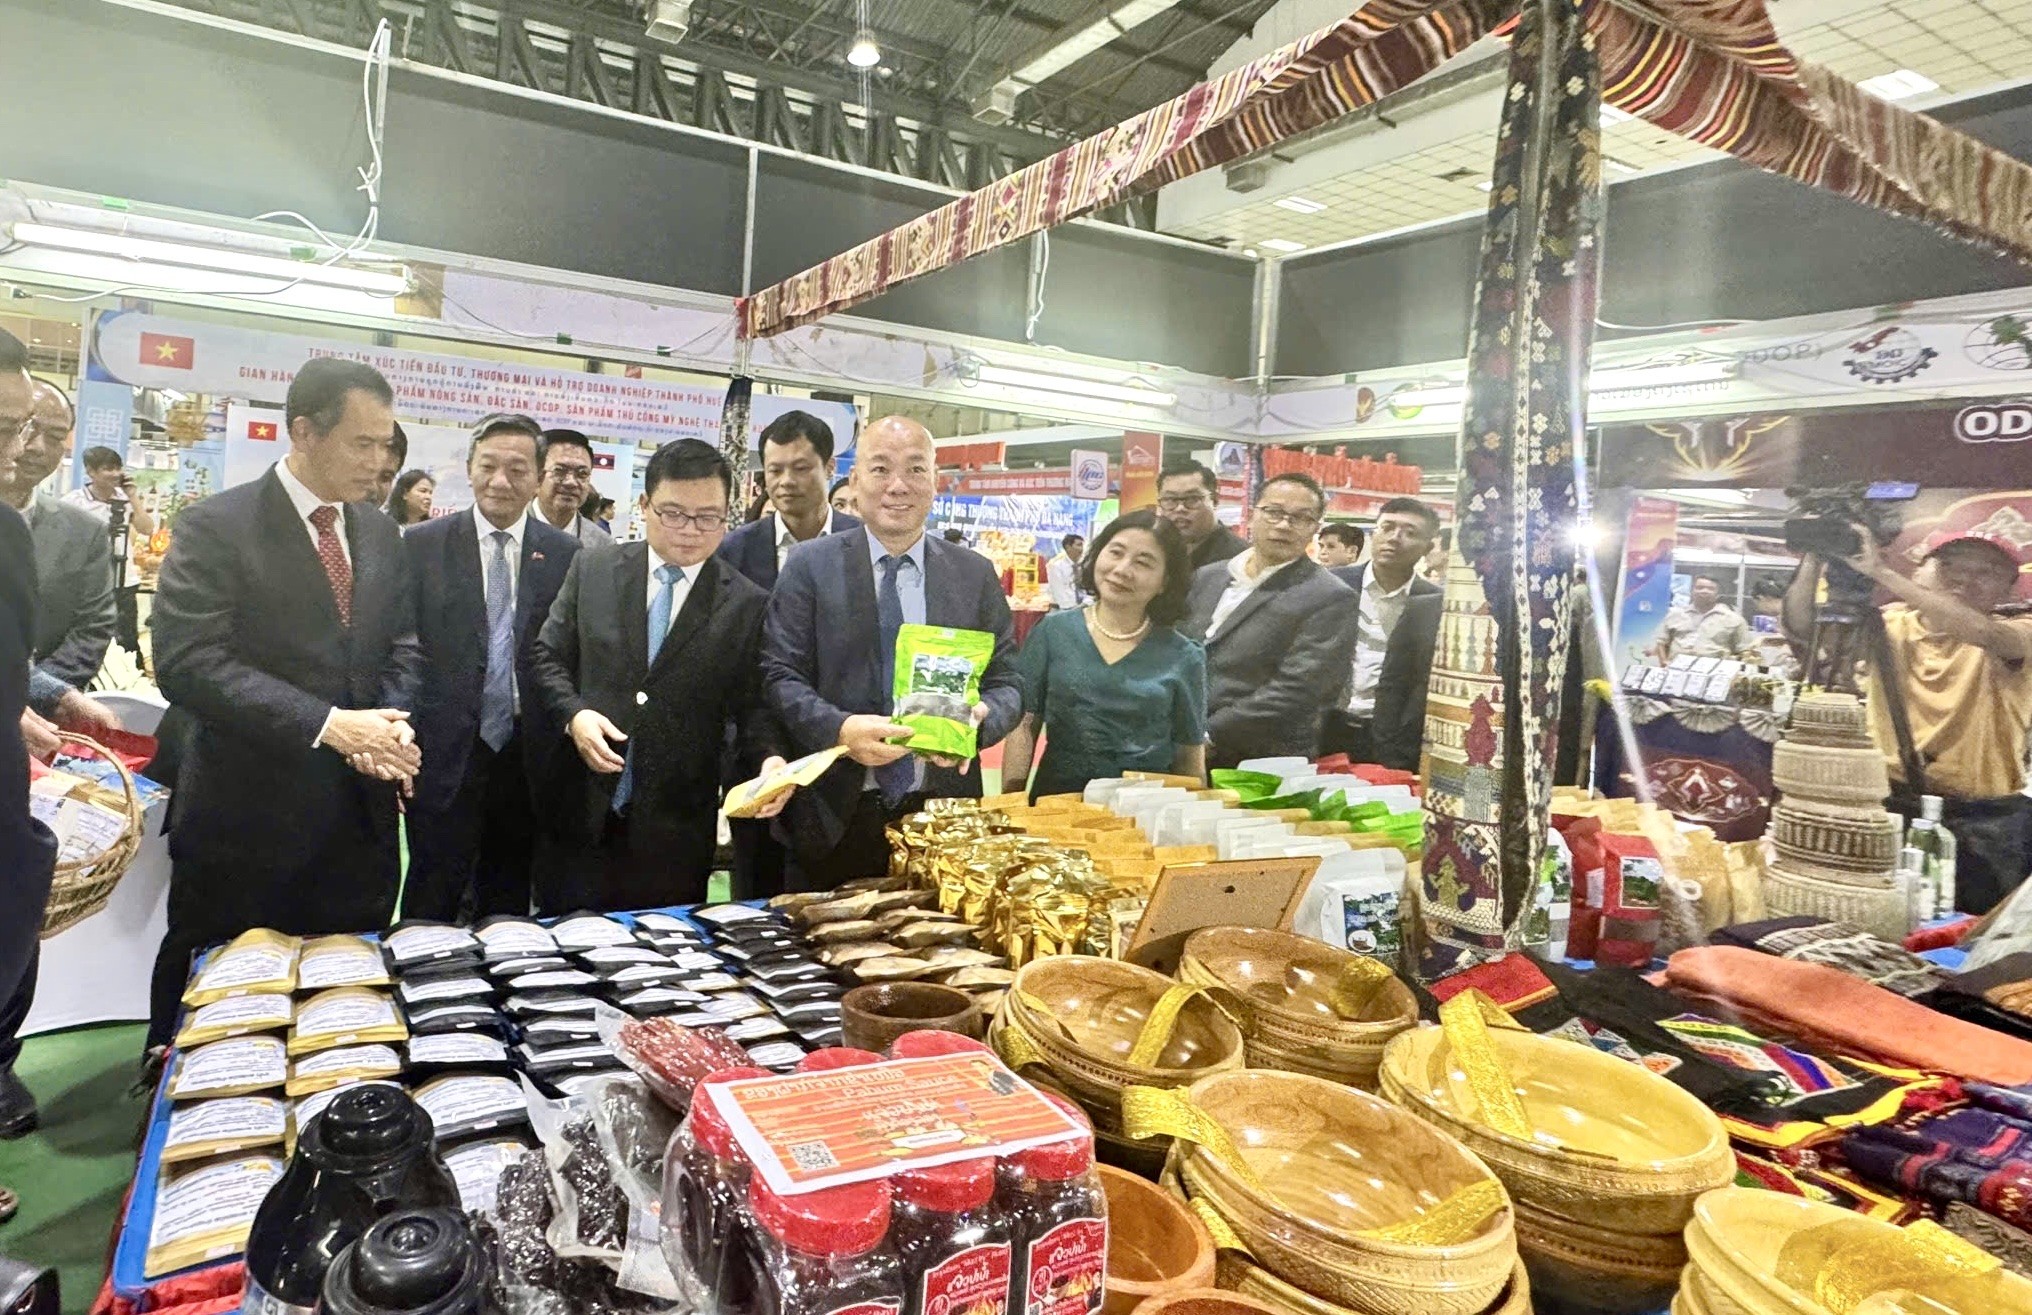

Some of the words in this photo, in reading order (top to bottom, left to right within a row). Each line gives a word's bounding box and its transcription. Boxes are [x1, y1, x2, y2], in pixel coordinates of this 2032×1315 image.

[239, 366, 266, 380] GIAN
[271, 369, 293, 383] HÀN
[534, 375, 547, 387] VÀ
[587, 381, 617, 395] DOANH
